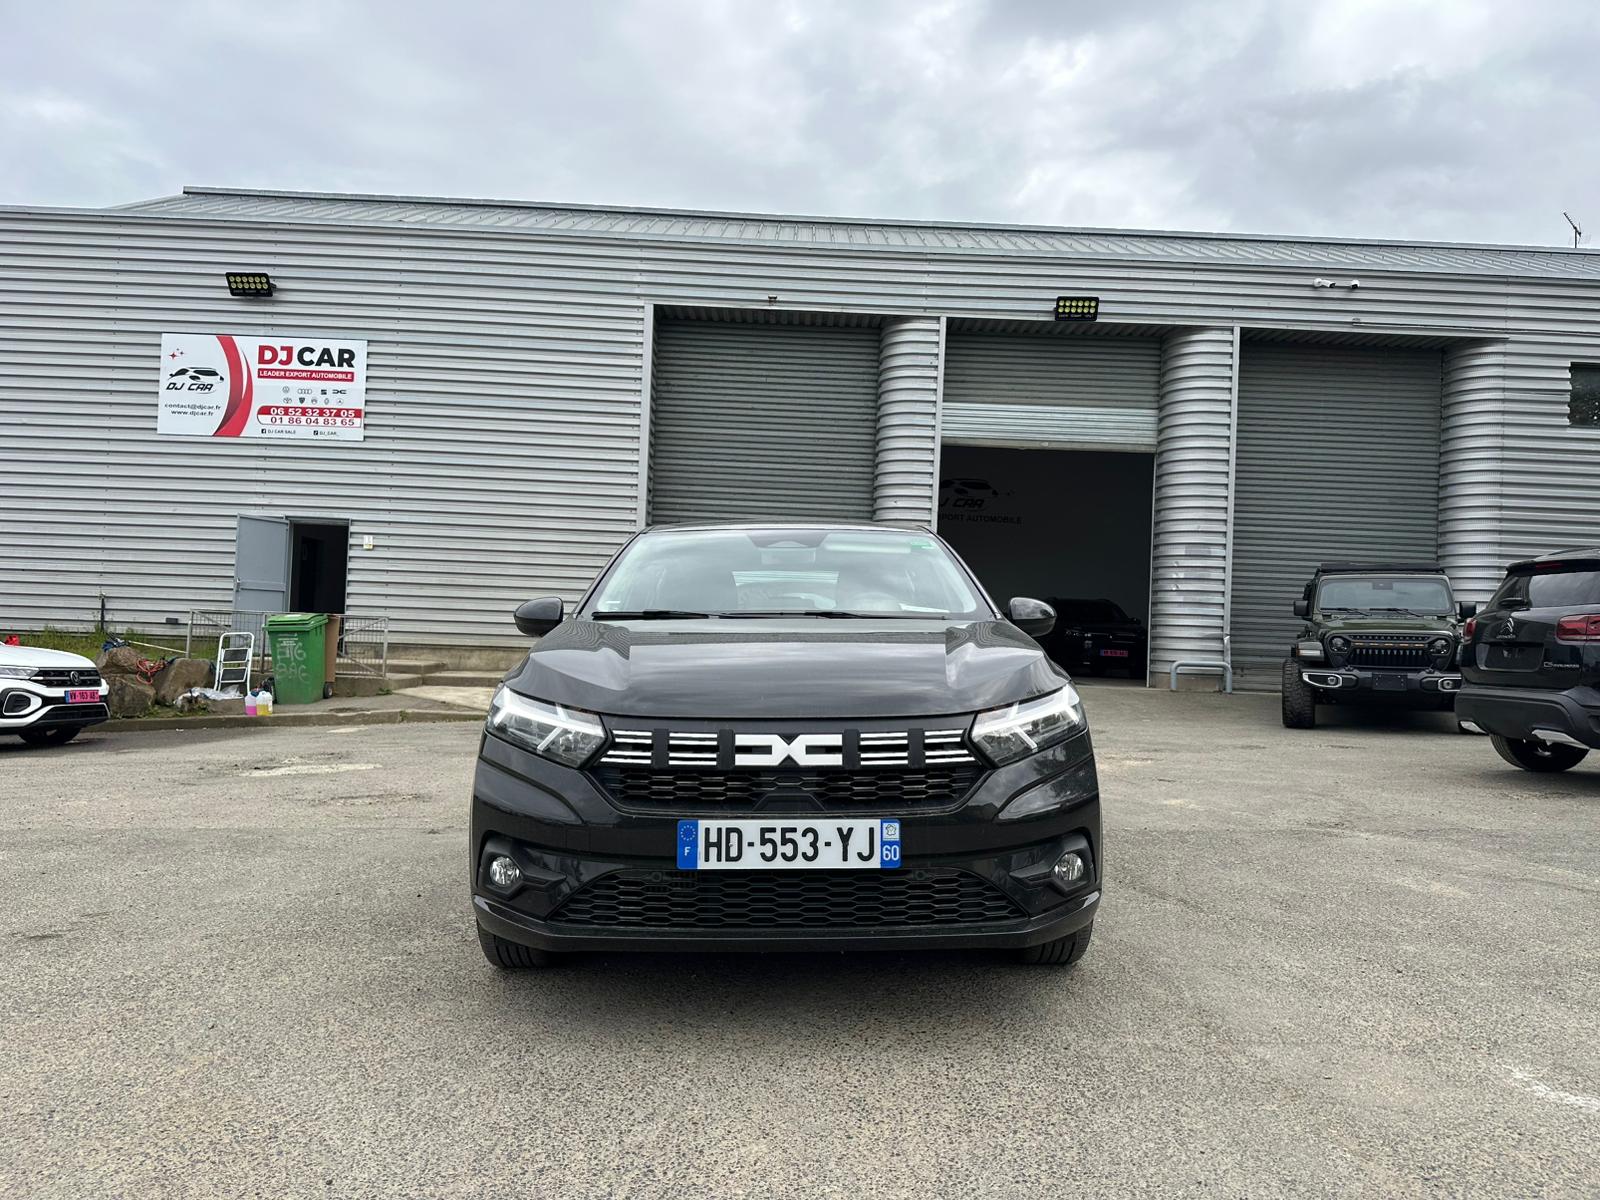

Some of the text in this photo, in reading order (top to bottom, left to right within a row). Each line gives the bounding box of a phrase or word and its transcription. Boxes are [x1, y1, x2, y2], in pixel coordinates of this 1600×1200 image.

[258, 345, 355, 368] DJ CAR
[311, 372, 352, 380] AUTOMOBILE
[166, 382, 214, 391] DJ CAR
[270, 407, 355, 418] 06 52 32 37 05
[270, 416, 354, 426] 01 86 04 83 65
[952, 497, 985, 508] CAR
[704, 826, 875, 862] HD-553-YJ
[684, 846, 691, 856] F
[882, 844, 900, 861] 60
